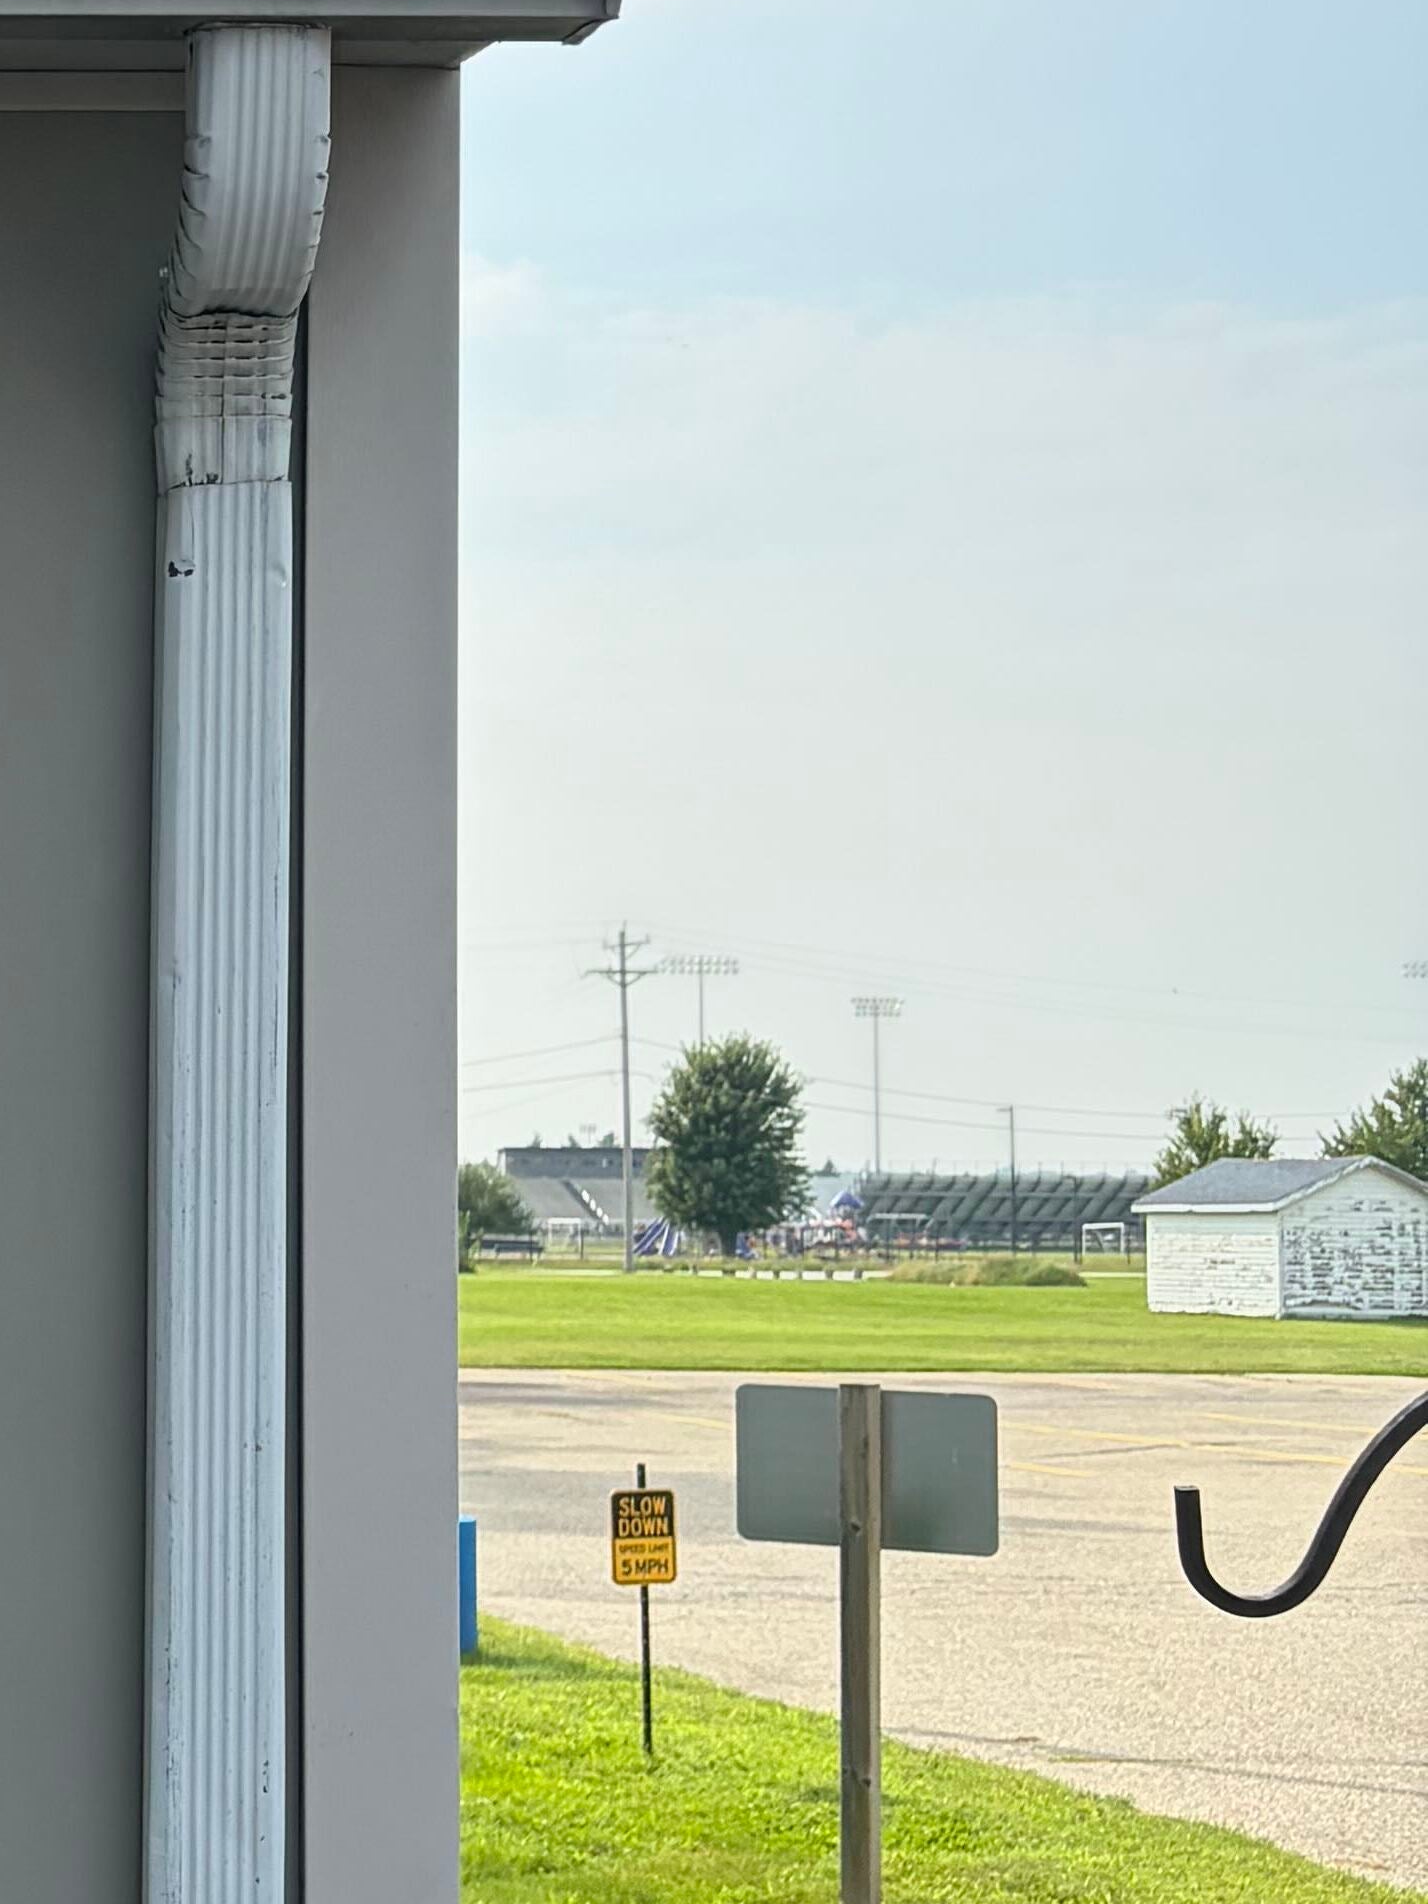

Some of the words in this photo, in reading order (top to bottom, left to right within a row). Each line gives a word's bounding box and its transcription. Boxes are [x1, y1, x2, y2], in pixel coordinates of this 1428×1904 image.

[619, 1496, 666, 1516] SLOW
[618, 1516, 669, 1538] DOWN
[621, 1558, 633, 1577] 5
[635, 1558, 669, 1575] MPH
